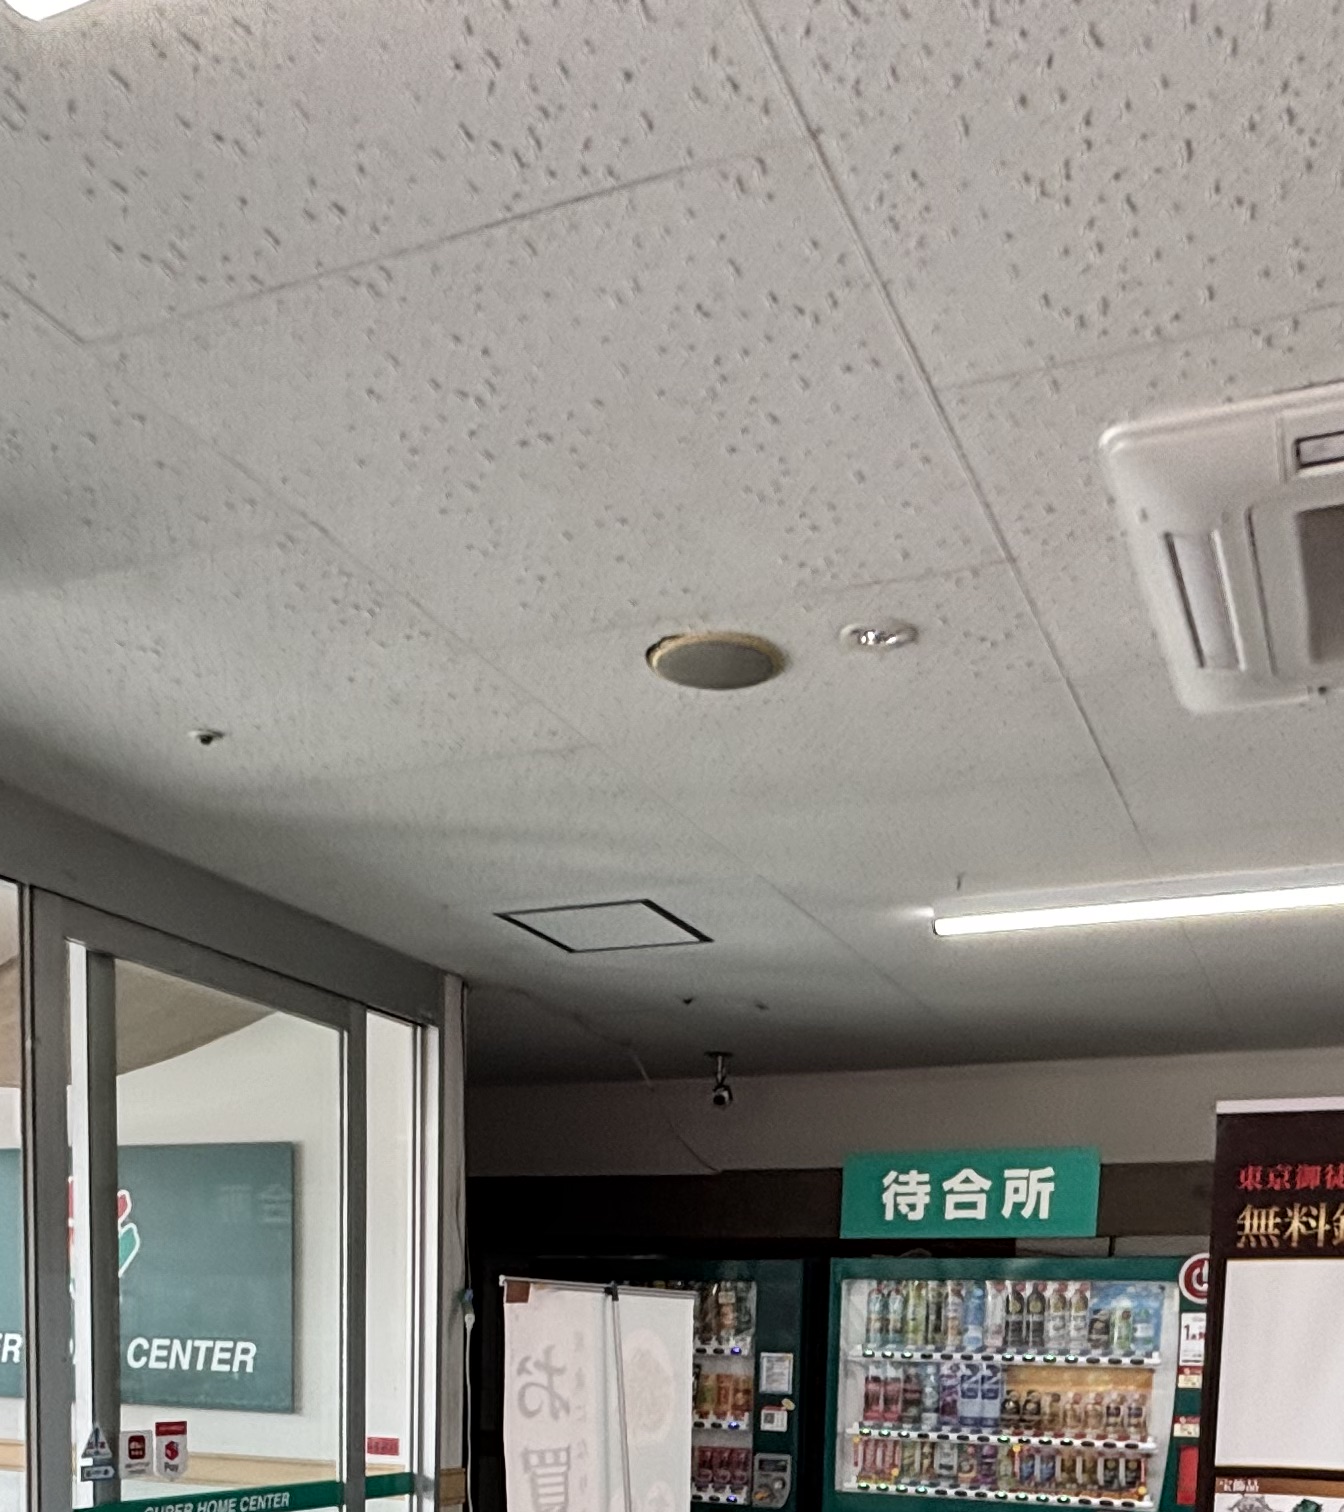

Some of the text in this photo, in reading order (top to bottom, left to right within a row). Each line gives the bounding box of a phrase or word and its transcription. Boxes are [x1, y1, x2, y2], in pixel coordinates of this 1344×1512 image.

[882, 1166, 1056, 1221] 待合所
[126, 1336, 257, 1374] CENTER
[239, 1490, 291, 1512] CENTER
